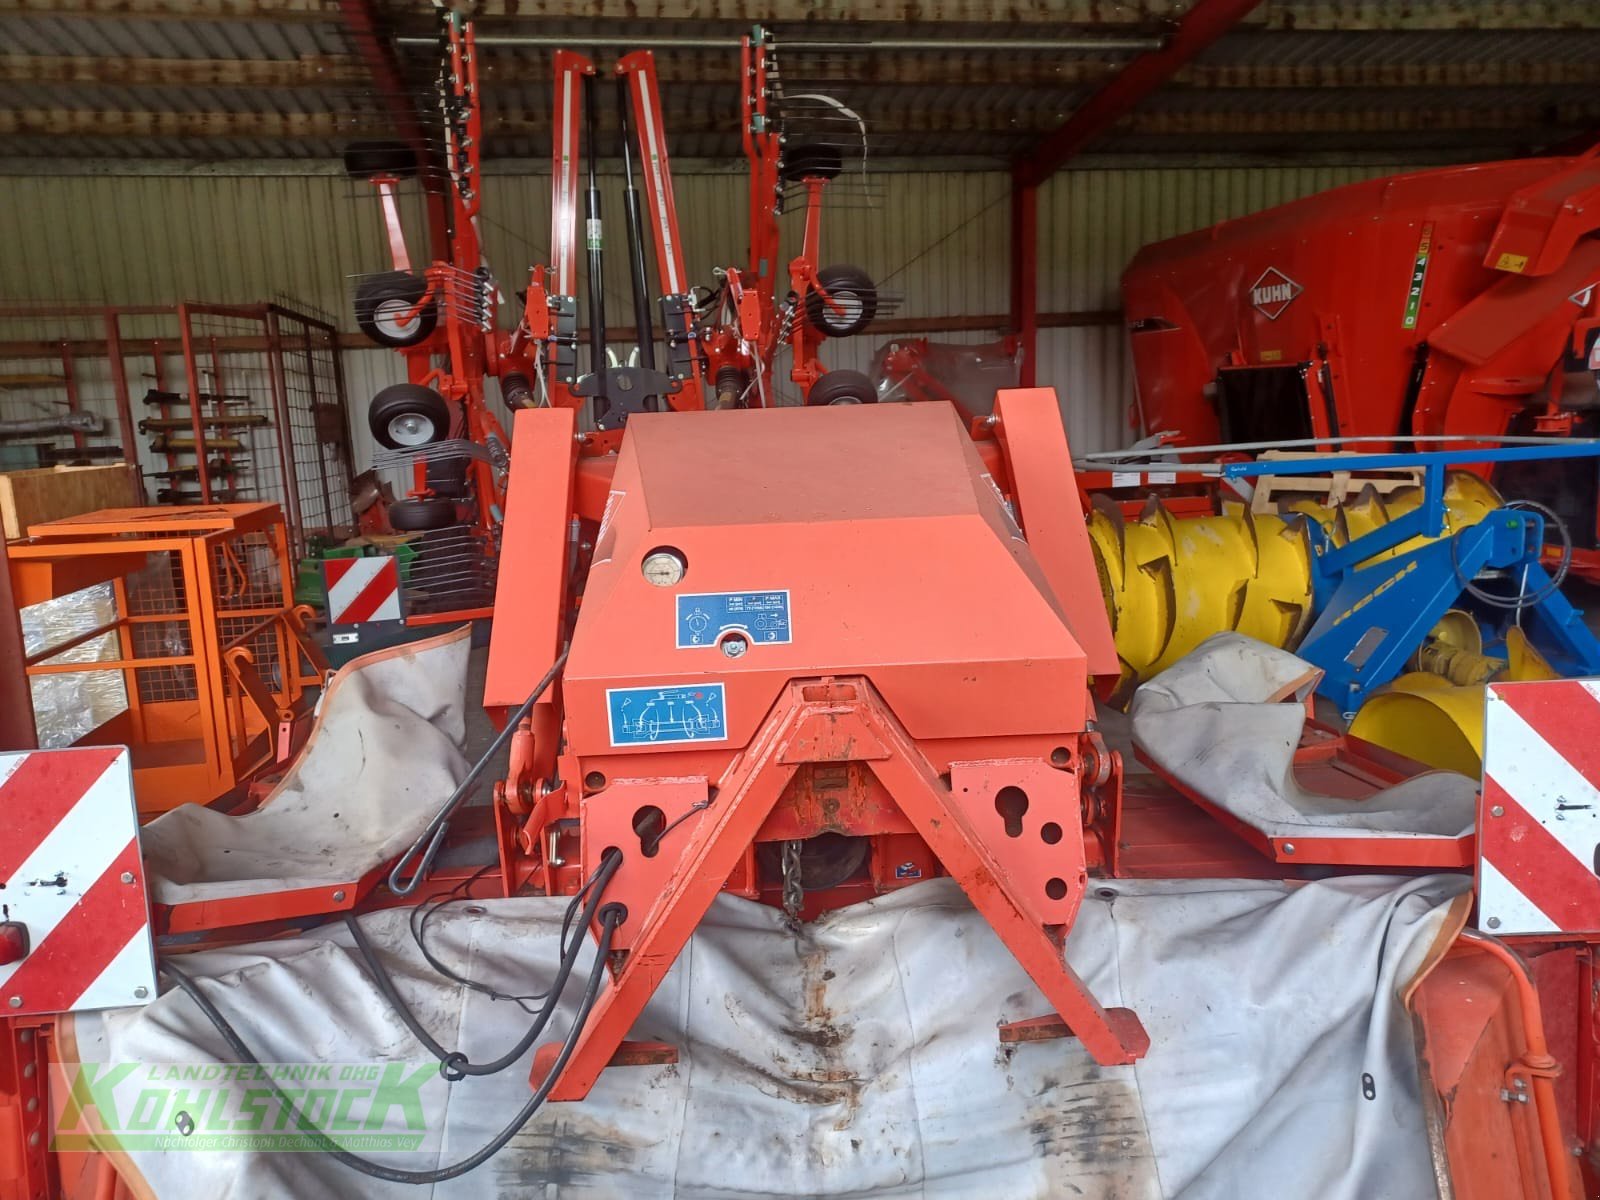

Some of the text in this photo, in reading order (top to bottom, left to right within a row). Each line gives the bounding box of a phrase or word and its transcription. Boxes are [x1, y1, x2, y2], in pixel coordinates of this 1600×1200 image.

[1416, 257, 1427, 266] 4
[1413, 272, 1423, 281] 3
[1252, 283, 1292, 305] KUHN
[1410, 287, 1420, 296] 2
[1405, 316, 1414, 325] 0
